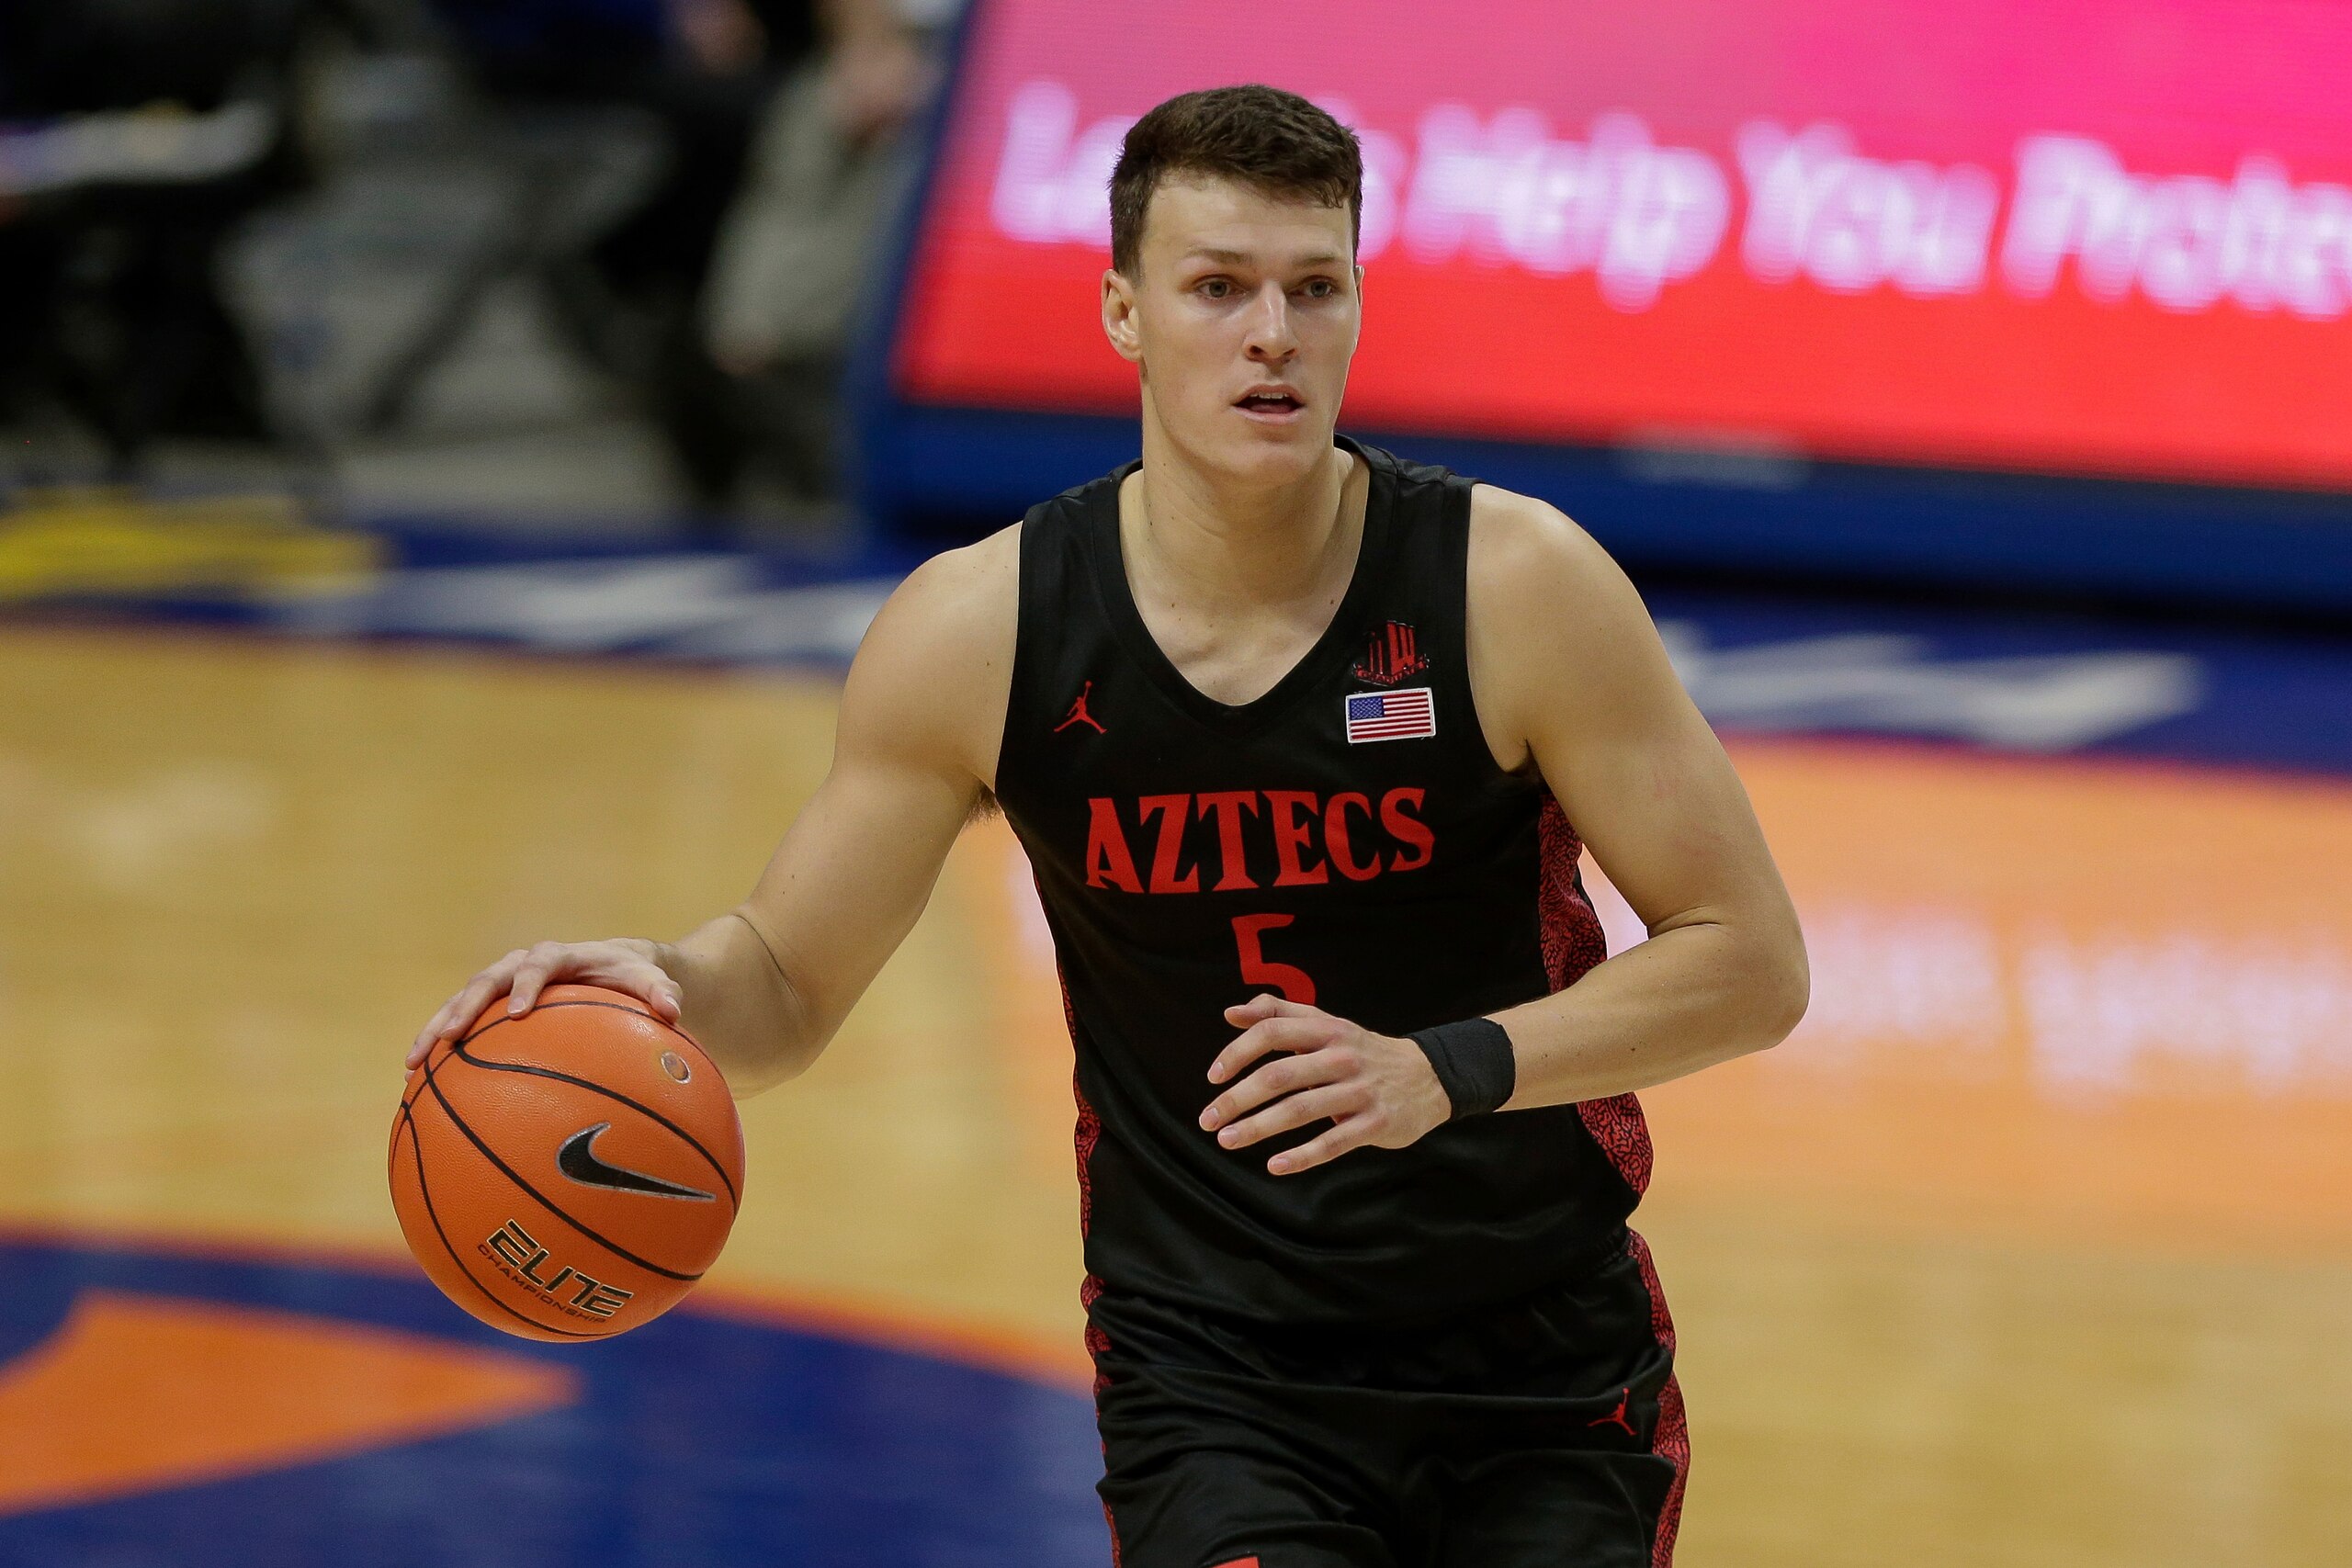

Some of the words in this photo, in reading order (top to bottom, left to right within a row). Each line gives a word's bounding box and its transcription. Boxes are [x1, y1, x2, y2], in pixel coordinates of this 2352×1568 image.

[1406, 105, 1731, 310] Help
[1736, 120, 1997, 296] You
[1085, 787, 1435, 894] AZTECS
[1231, 913, 1317, 1007] 5
[477, 1244, 606, 1324] CHAMPIONSHIP
[486, 1218, 634, 1317] ELITE
